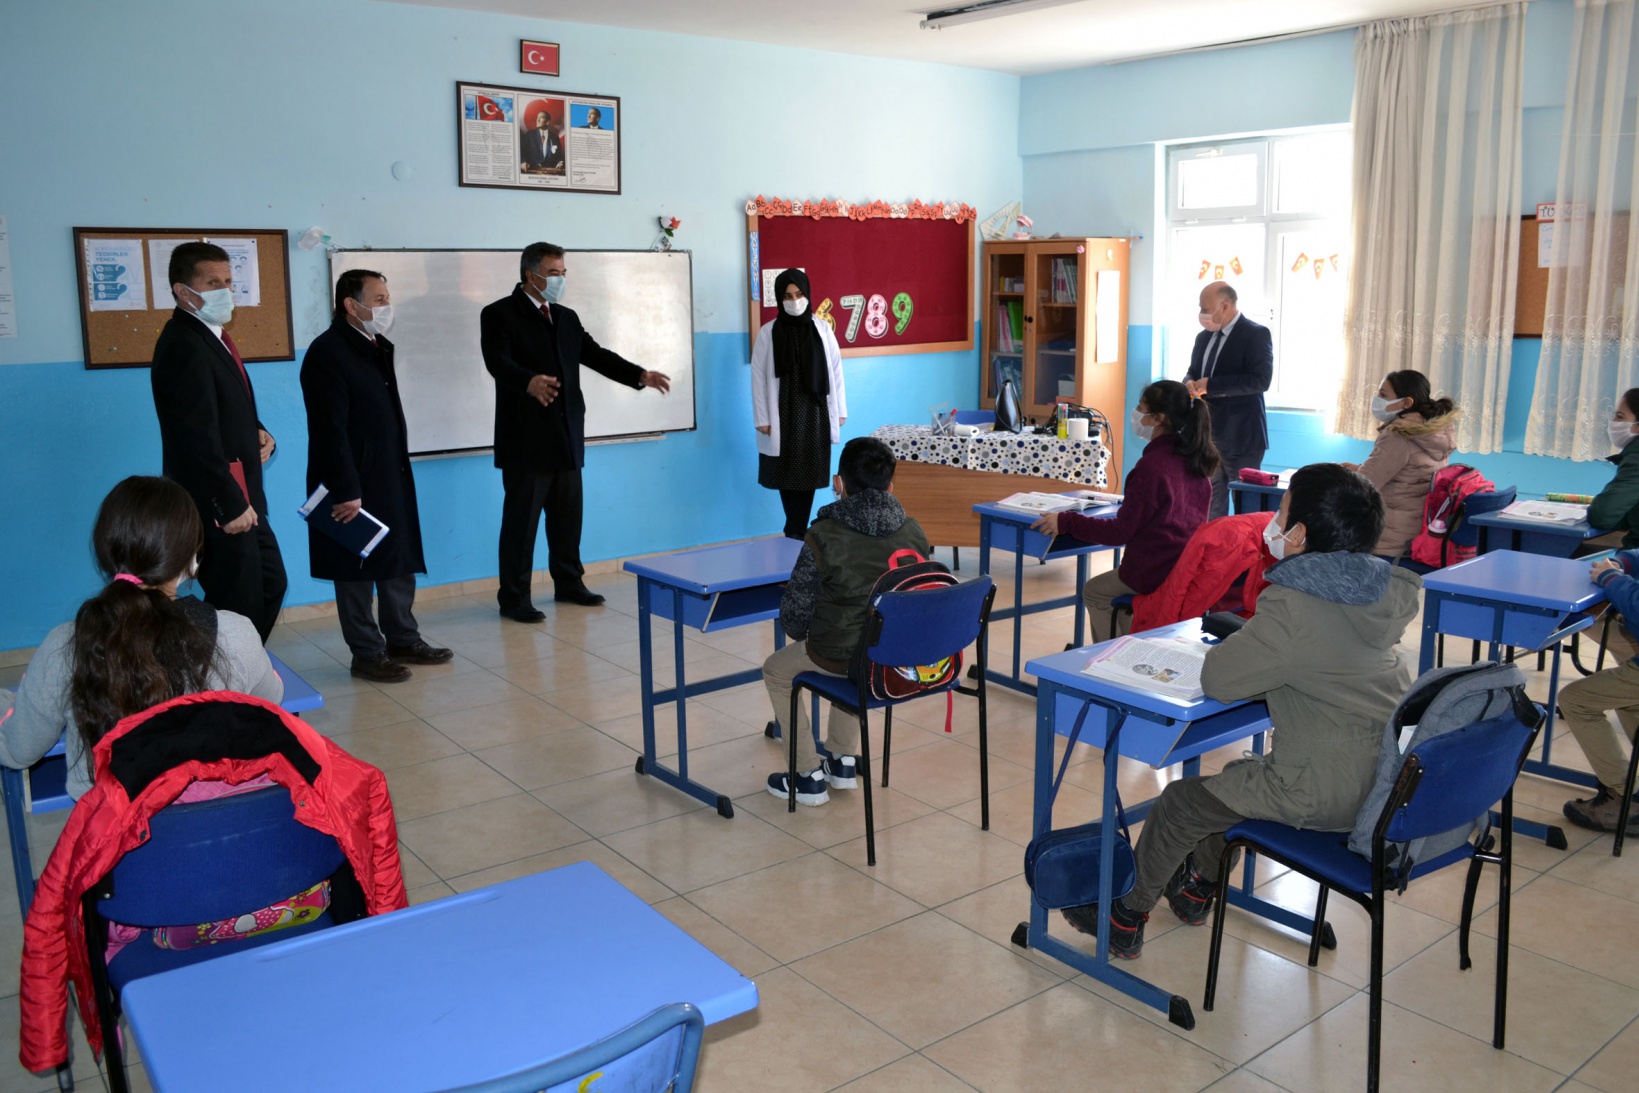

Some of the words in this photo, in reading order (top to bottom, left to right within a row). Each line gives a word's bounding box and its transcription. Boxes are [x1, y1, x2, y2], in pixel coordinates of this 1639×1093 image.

[756, 199, 766, 207] Bb
[764, 207, 773, 215] Cc
[793, 204, 802, 212] Ee
[858, 209, 866, 217] Kk
[891, 206, 899, 214] Oo
[840, 294, 866, 342] 7
[865, 294, 888, 338] 8
[892, 292, 914, 335] 9
